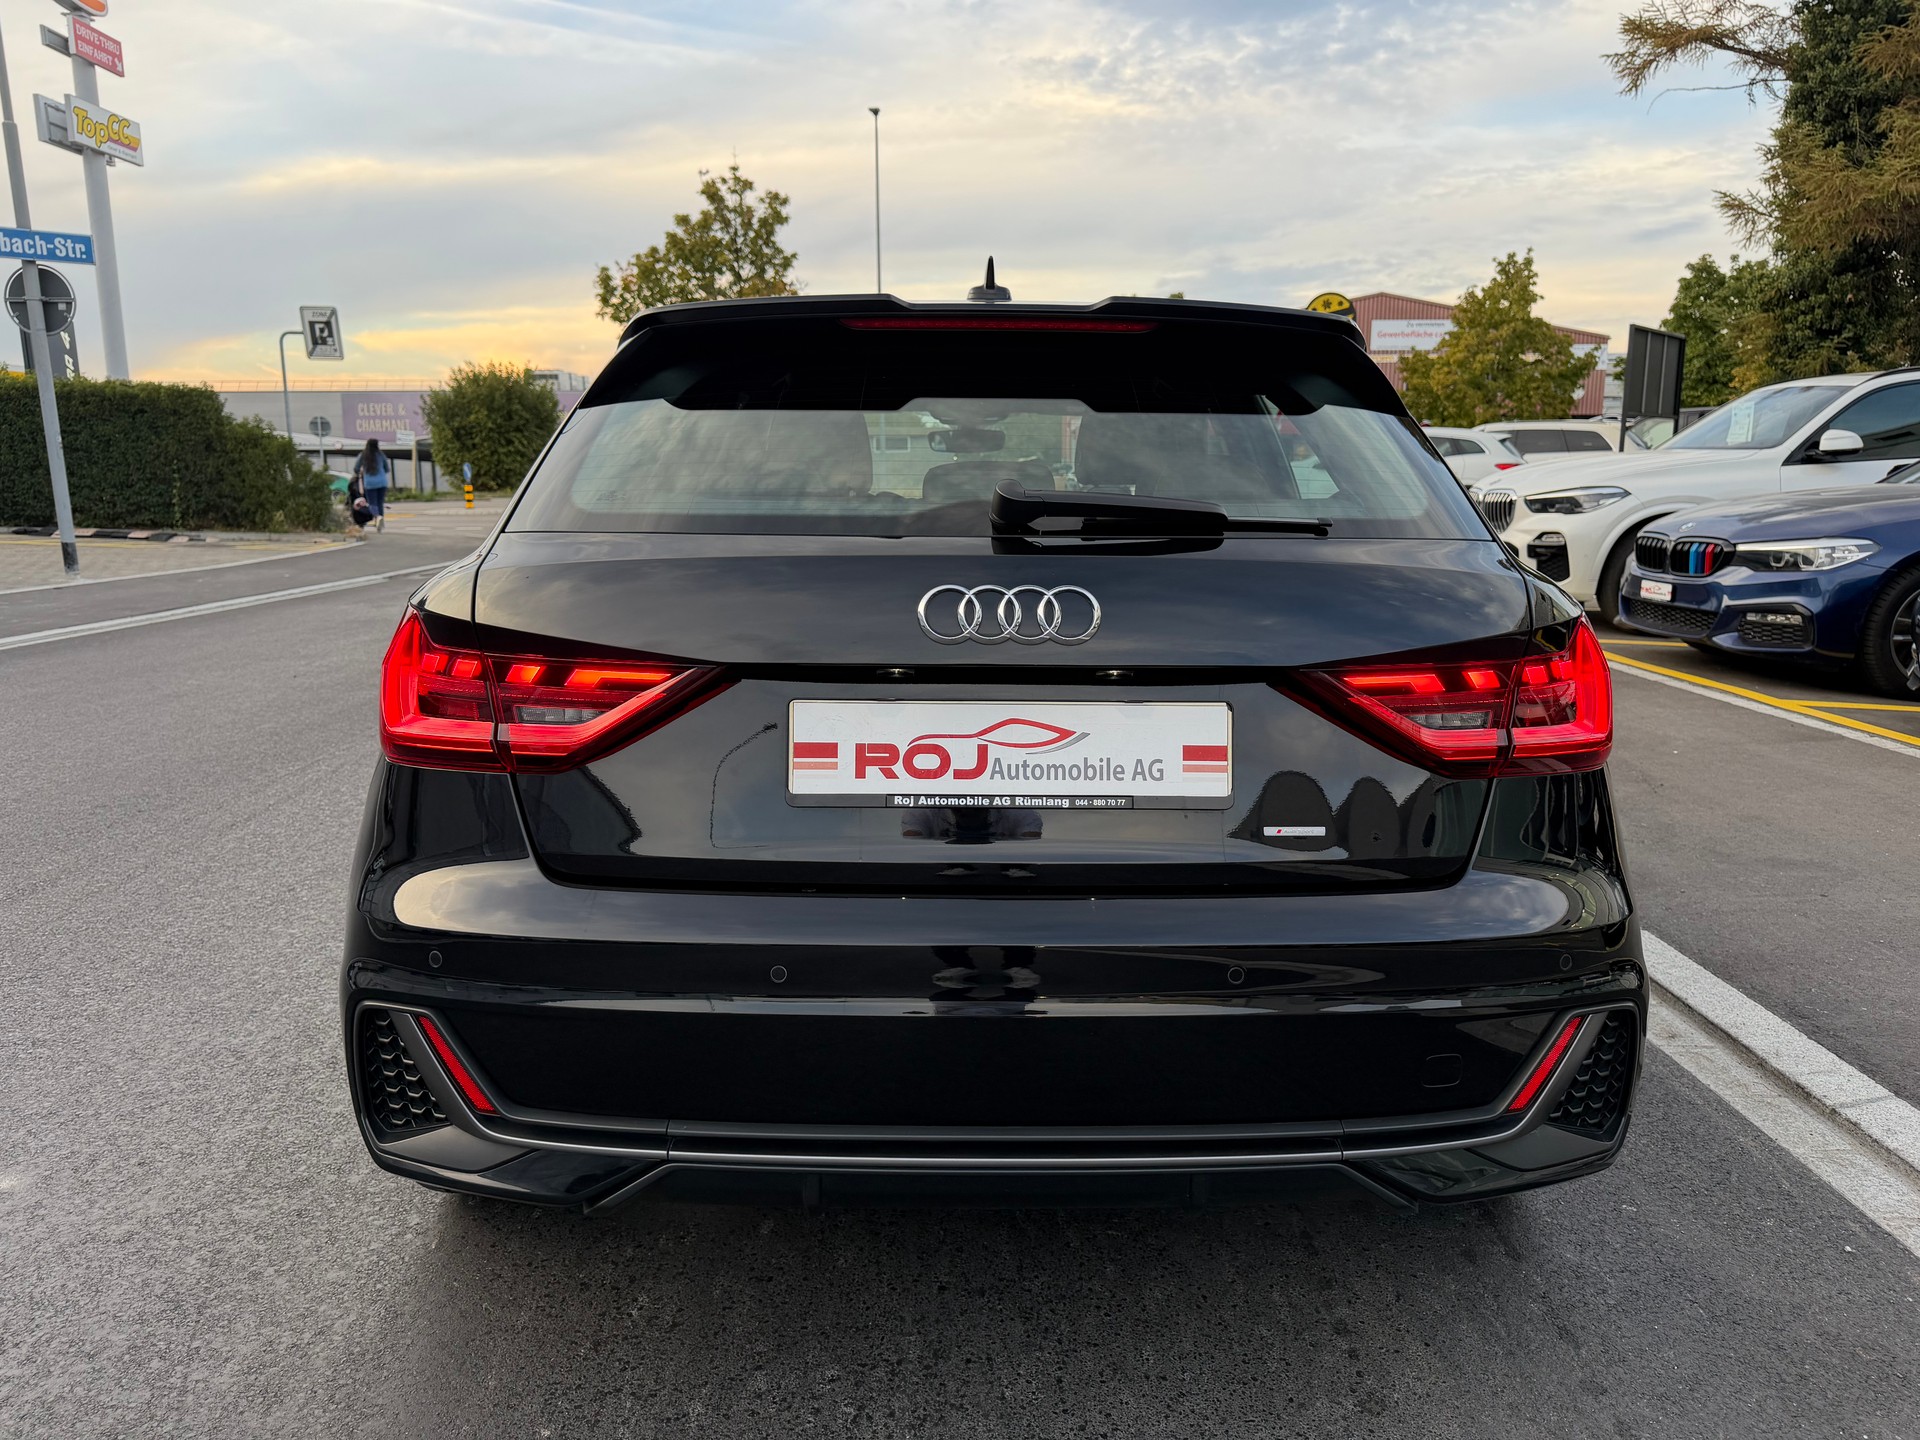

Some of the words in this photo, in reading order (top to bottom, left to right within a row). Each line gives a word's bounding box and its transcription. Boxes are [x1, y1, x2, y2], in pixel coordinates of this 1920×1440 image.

[76, 23, 99, 45] DRIVE
[100, 36, 120, 55] THRU
[78, 40, 113, 66] EINFAHRT
[73, 106, 131, 148] TopCC
[0, 232, 87, 259] bach-Str.
[358, 403, 394, 416] CLEVER
[397, 403, 407, 416] &
[356, 419, 410, 432] CHARMANT
[855, 743, 989, 780] ROJ
[989, 757, 1125, 782] Automobile
[1131, 758, 1164, 782] AG
[894, 796, 914, 807] Roj
[918, 796, 990, 806] Automobile
[993, 797, 1011, 806] AG
[1015, 797, 1070, 808] Rümlang
